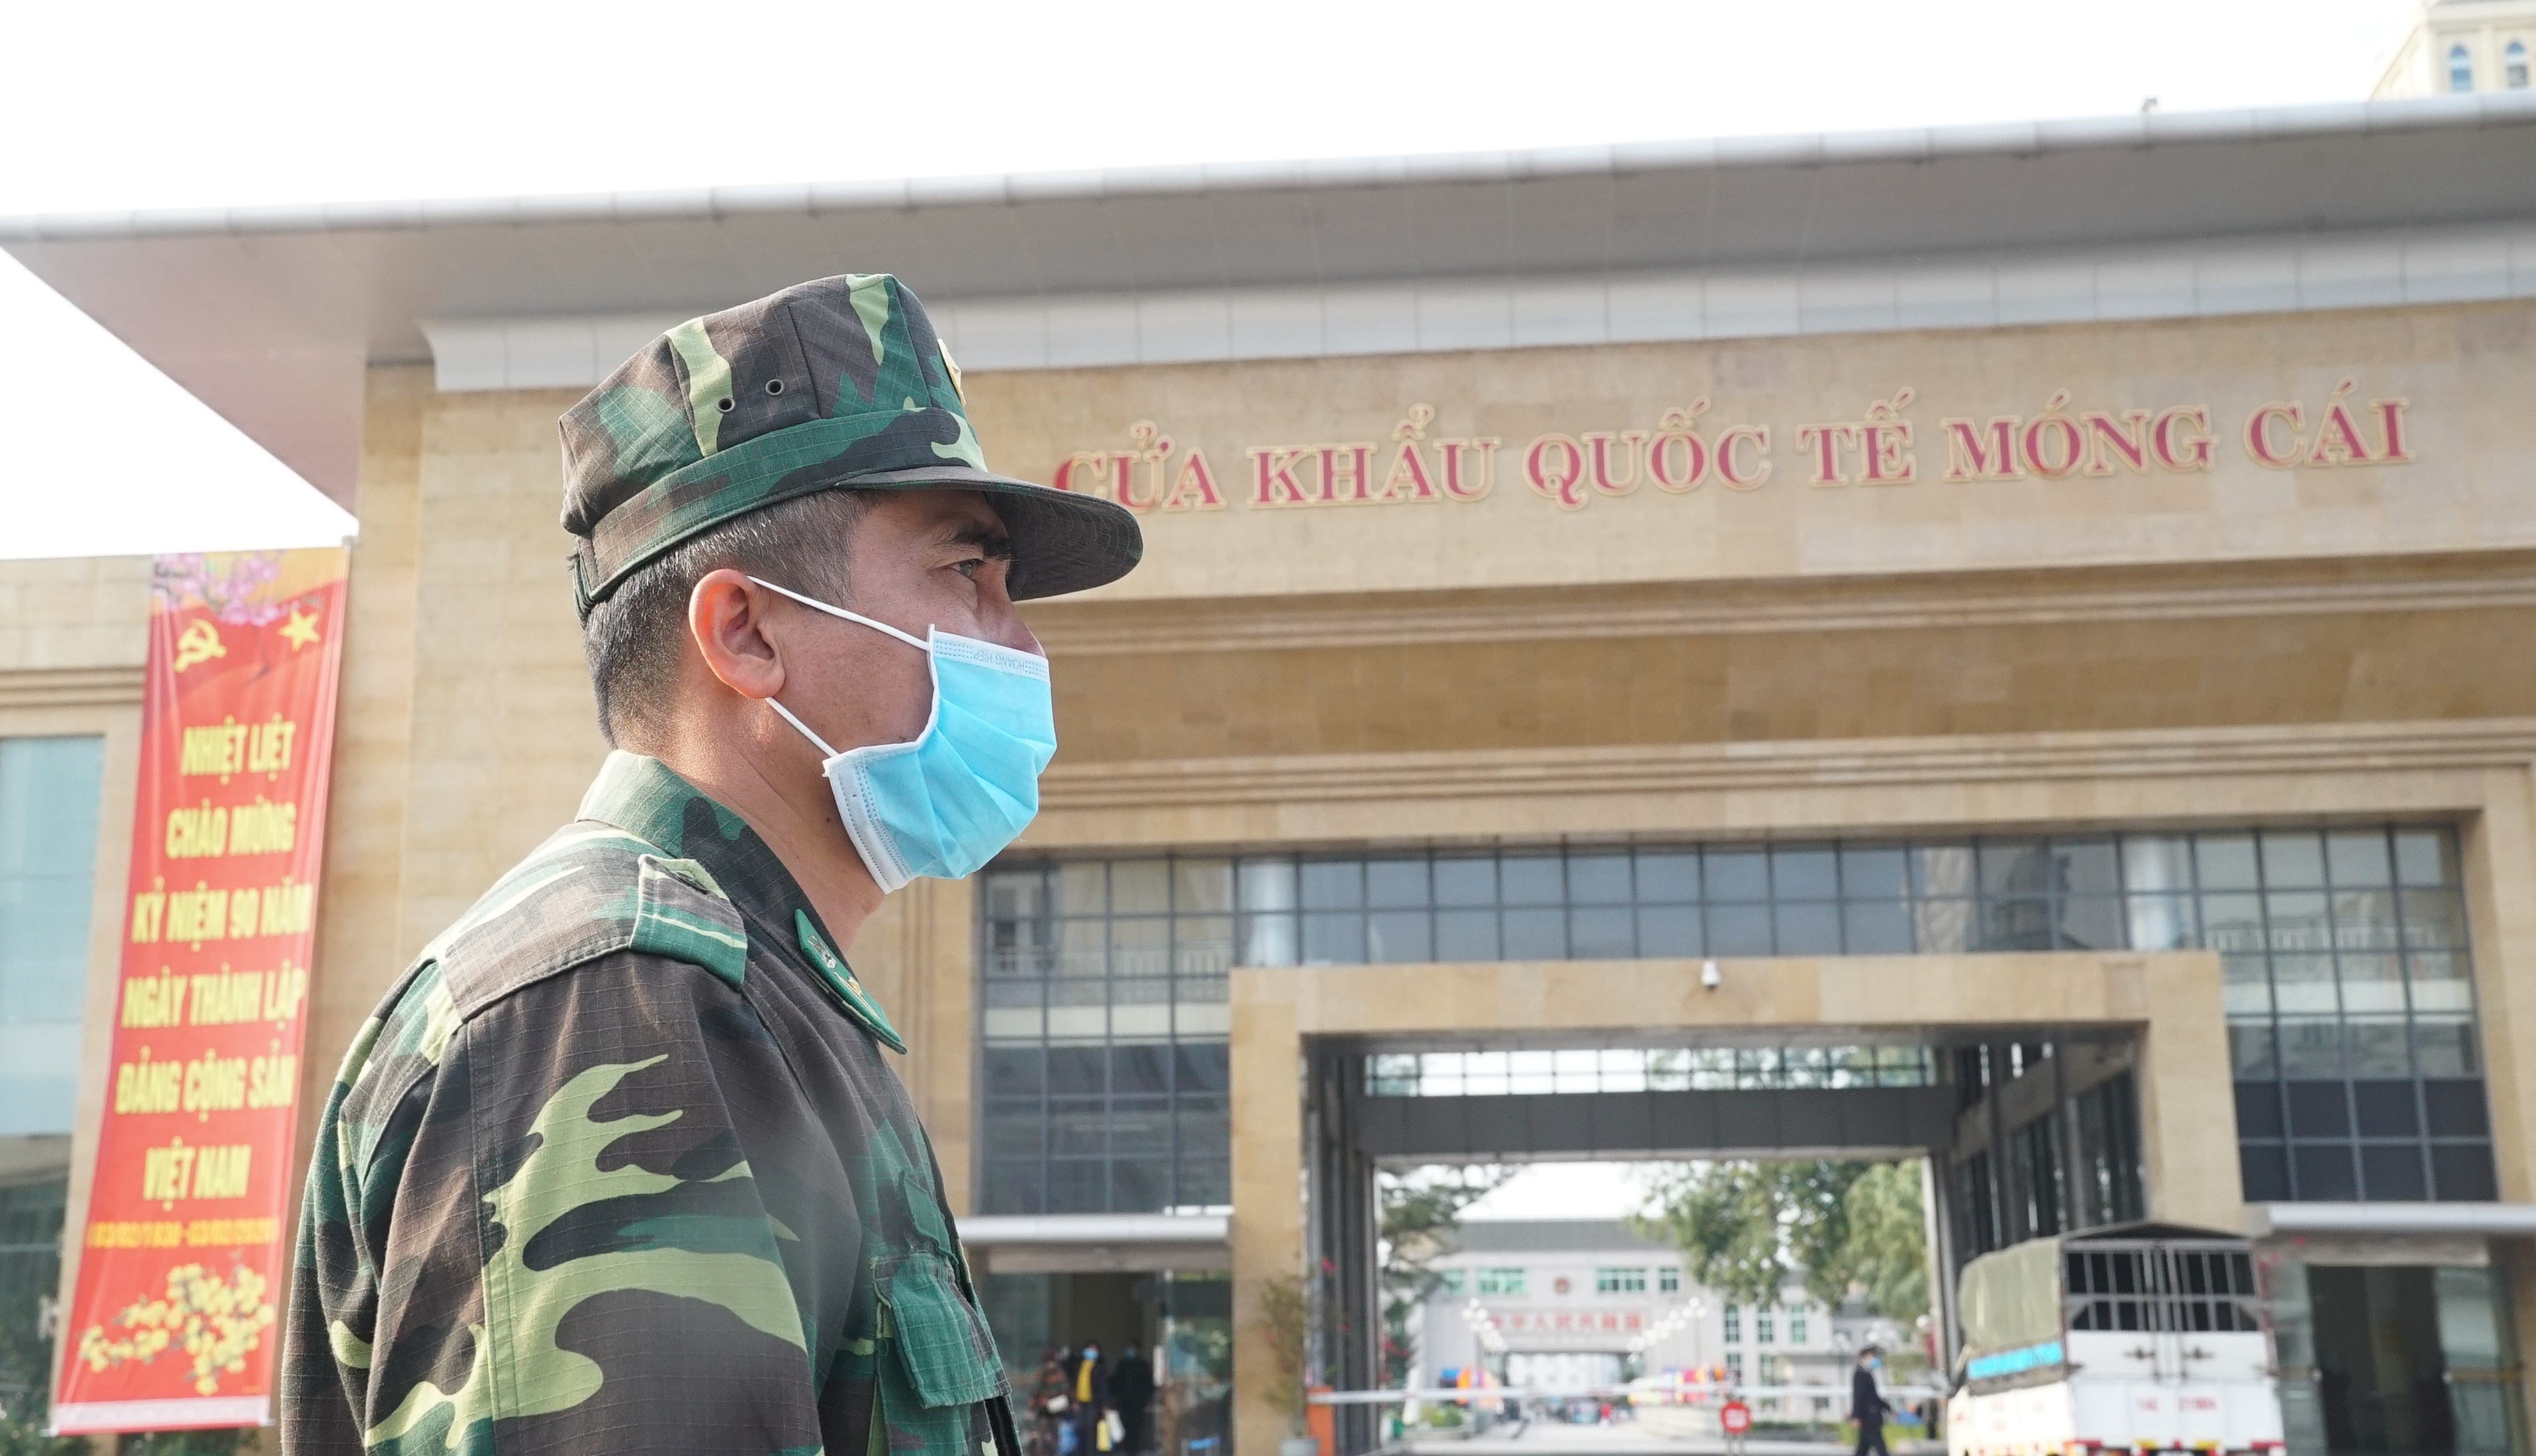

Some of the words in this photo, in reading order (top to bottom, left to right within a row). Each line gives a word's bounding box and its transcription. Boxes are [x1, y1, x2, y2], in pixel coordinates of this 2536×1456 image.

[1051, 420, 1227, 513] CỬA
[1246, 403, 1502, 510] KHẨU
[1523, 396, 1772, 511] QUỐC
[1797, 386, 1917, 488] TẾ
[1939, 388, 2218, 482] MÓNG
[2243, 375, 2416, 470] CÁI
[995, 653, 1025, 671] HOANG
[180, 716, 248, 785] NHIỆT
[248, 712, 297, 782] LIỆT
[143, 1135, 196, 1212] VIỆT
[193, 1145, 252, 1199] NAM
